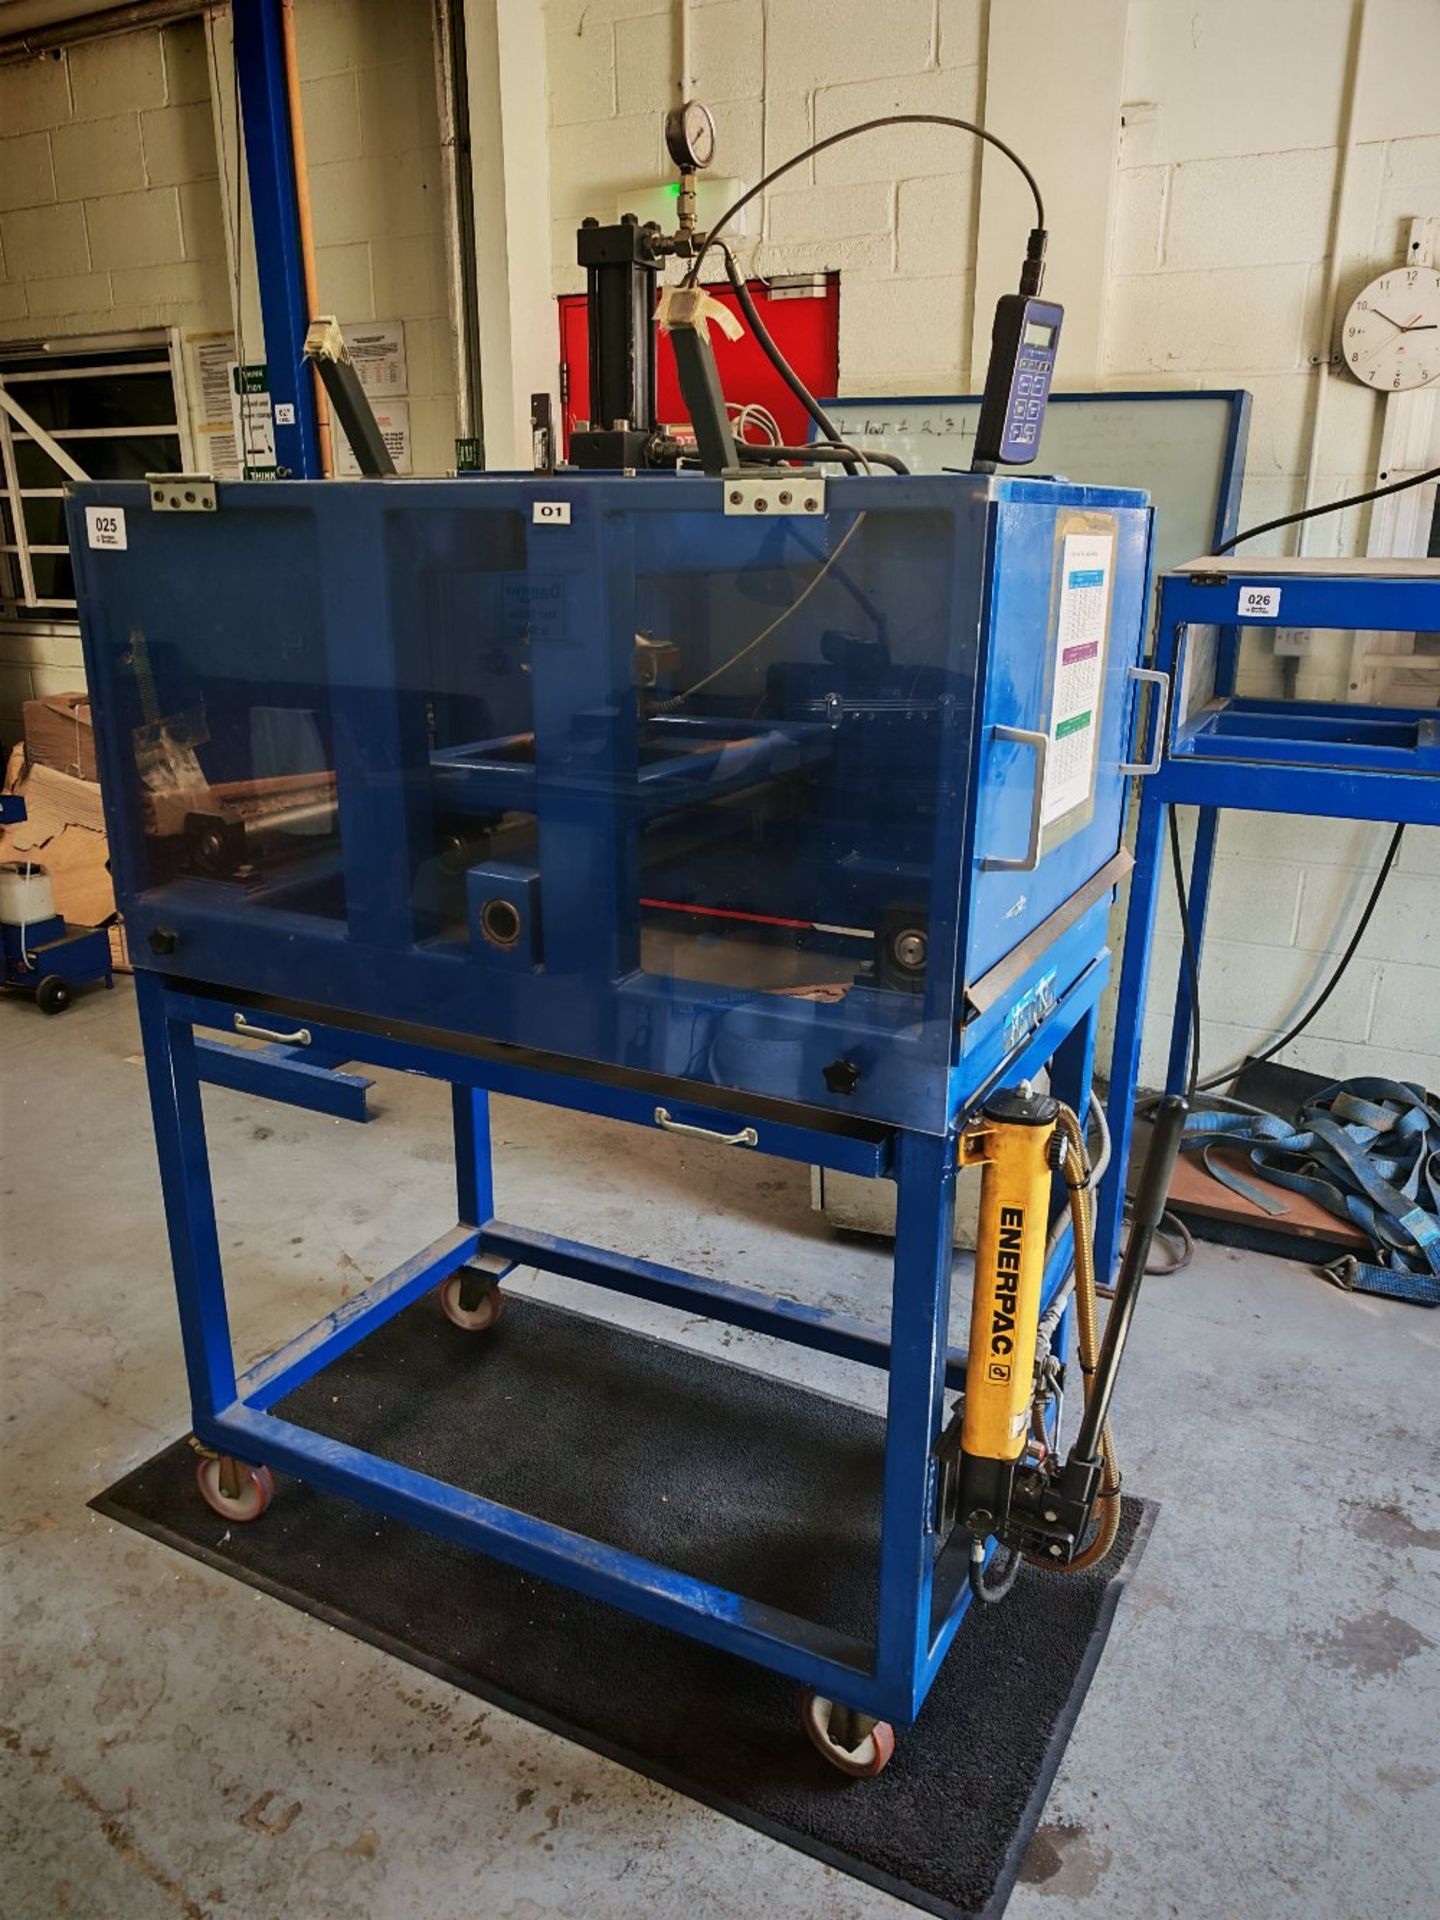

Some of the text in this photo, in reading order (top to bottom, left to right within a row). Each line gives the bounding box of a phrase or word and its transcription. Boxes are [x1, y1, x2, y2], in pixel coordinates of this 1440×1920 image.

[1407, 271, 1418, 281] 12
[1380, 281, 1390, 290] 11
[1357, 301, 1368, 310] 10
[1349, 327, 1356, 338] 9
[1352, 353, 1359, 362] 8
[1369, 371, 1376, 381] 7
[1422, 370, 1428, 380] 5
[1393, 378, 1401, 388] 6
[249, 471, 276, 480] THINK
[96, 517, 117, 532] 025
[1248, 594, 1271, 605] 026
[991, 1206, 1024, 1355] ENERPAC
